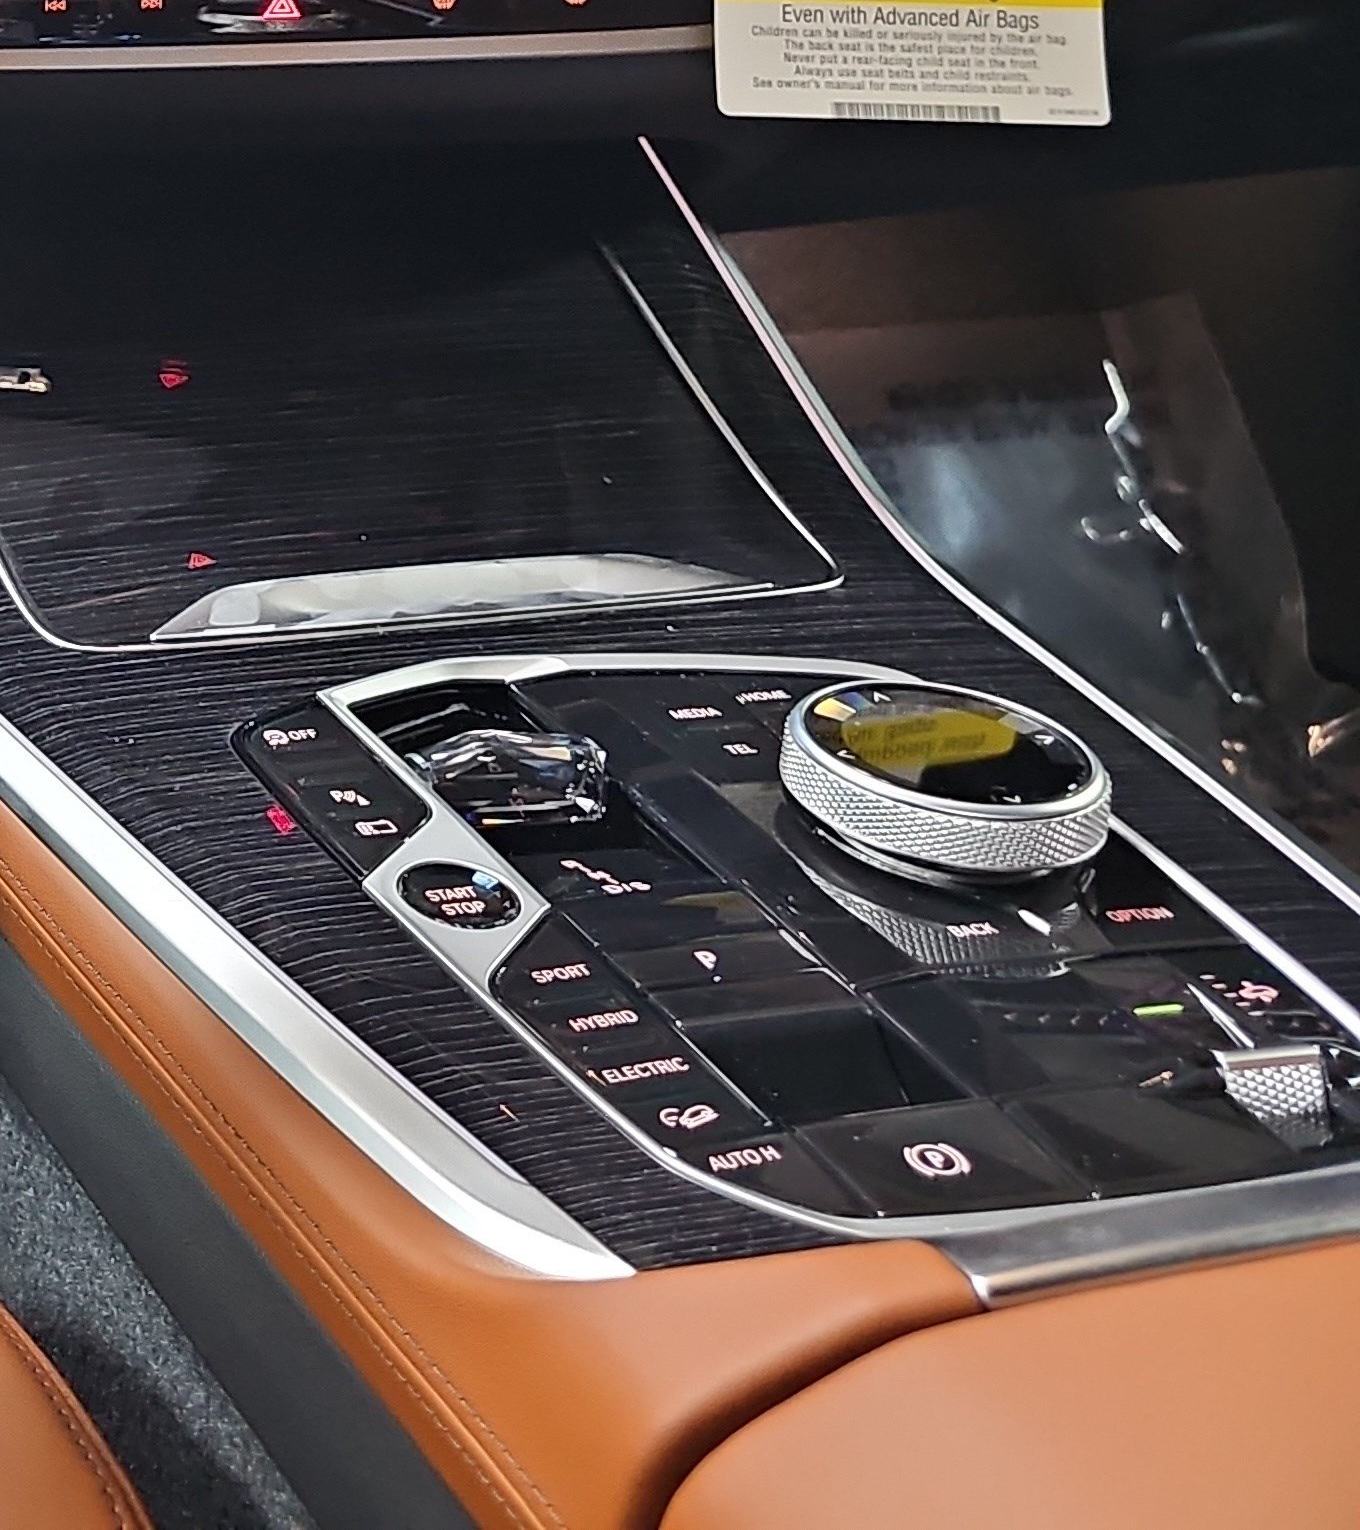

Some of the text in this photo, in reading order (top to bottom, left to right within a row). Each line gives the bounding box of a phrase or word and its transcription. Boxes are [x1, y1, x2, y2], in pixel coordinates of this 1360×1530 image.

[782, 4, 1039, 31] Even with Advanced Air Bags
[751, 25, 798, 37] Children
[802, 28, 821, 37] can
[826, 27, 839, 38] be
[877, 30, 888, 39] or
[892, 29, 942, 43] seriously
[990, 33, 1002, 44] by
[1007, 33, 1024, 43] the
[785, 39, 804, 50] The
[808, 40, 833, 51] back
[838, 41, 861, 51] seat
[865, 42, 875, 52] is
[878, 41, 896, 52] the
[900, 42, 933, 54] safest
[937, 45, 966, 57] place
[970, 45, 985, 55] for
[783, 52, 815, 63] Never
[820, 53, 838, 65] put
[841, 56, 848, 64] a
[852, 55, 912, 68] rear-facing
[916, 56, 943, 67] child
[948, 57, 970, 67] seat
[974, 58, 985, 67] in
[989, 57, 1006, 68] the
[793, 65, 833, 78] Always
[837, 68, 857, 77] use
[861, 67, 884, 78] seat
[888, 68, 915, 79] belts
[919, 70, 939, 80] and
[943, 70, 970, 80] child
[752, 77, 773, 88] See
[824, 80, 865, 90] manual
[869, 80, 884, 90] for
[889, 81, 918, 91] more
[921, 82, 987, 94] information
[991, 84, 1023, 95] about
[667, 706, 723, 720] MEDIA
[287, 728, 317, 741] OFF
[722, 743, 760, 755] TEL
[425, 886, 477, 902] START
[441, 900, 486, 916] STOP
[1105, 906, 1175, 924] OPTION
[947, 922, 1000, 939] BACK
[693, 950, 717, 970] P
[531, 963, 591, 985] SPORT
[568, 1009, 639, 1032] HYBRID
[604, 1057, 690, 1084] ELECTRIC
[708, 1144, 782, 1172] AUTO H
[923, 1150, 945, 1169] P
